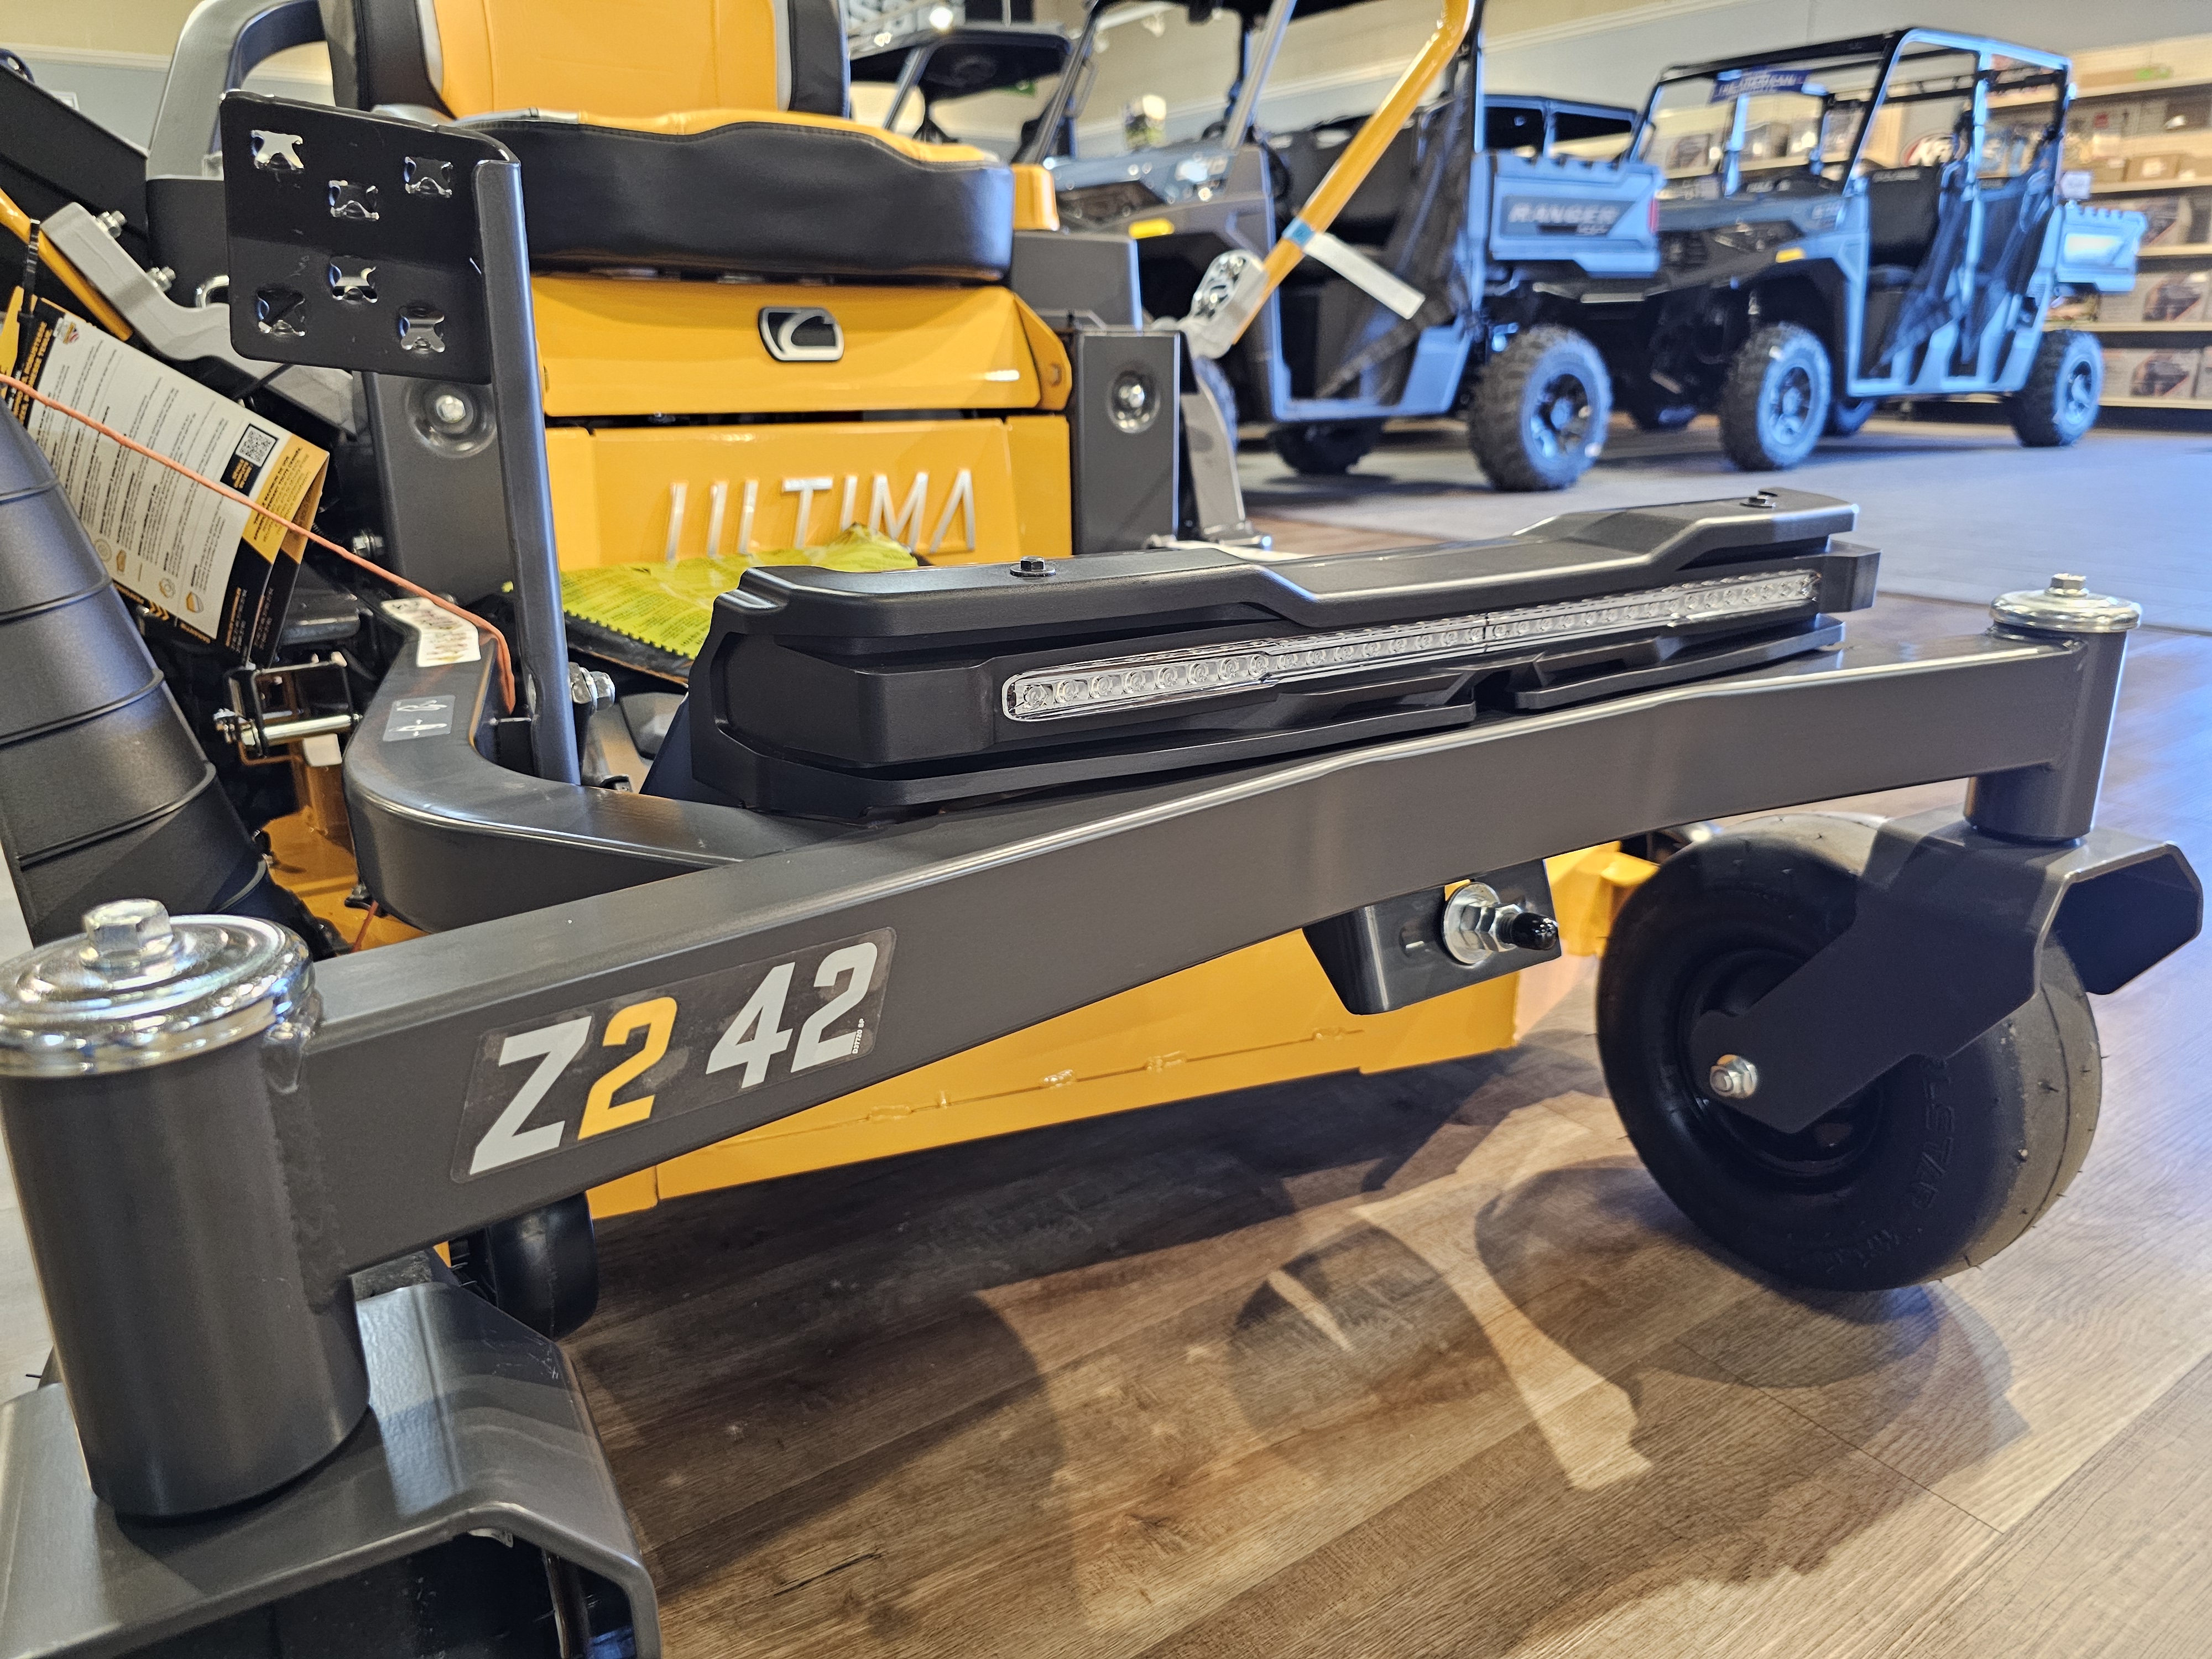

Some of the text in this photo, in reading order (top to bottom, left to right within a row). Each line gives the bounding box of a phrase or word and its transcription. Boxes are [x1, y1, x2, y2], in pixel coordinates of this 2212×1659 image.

[1510, 202, 1619, 223] RANGER
[665, 468, 975, 561] ULTIMA
[469, 941, 878, 1176] Z2 42
[852, 1018, 865, 1054] D37720 SP
